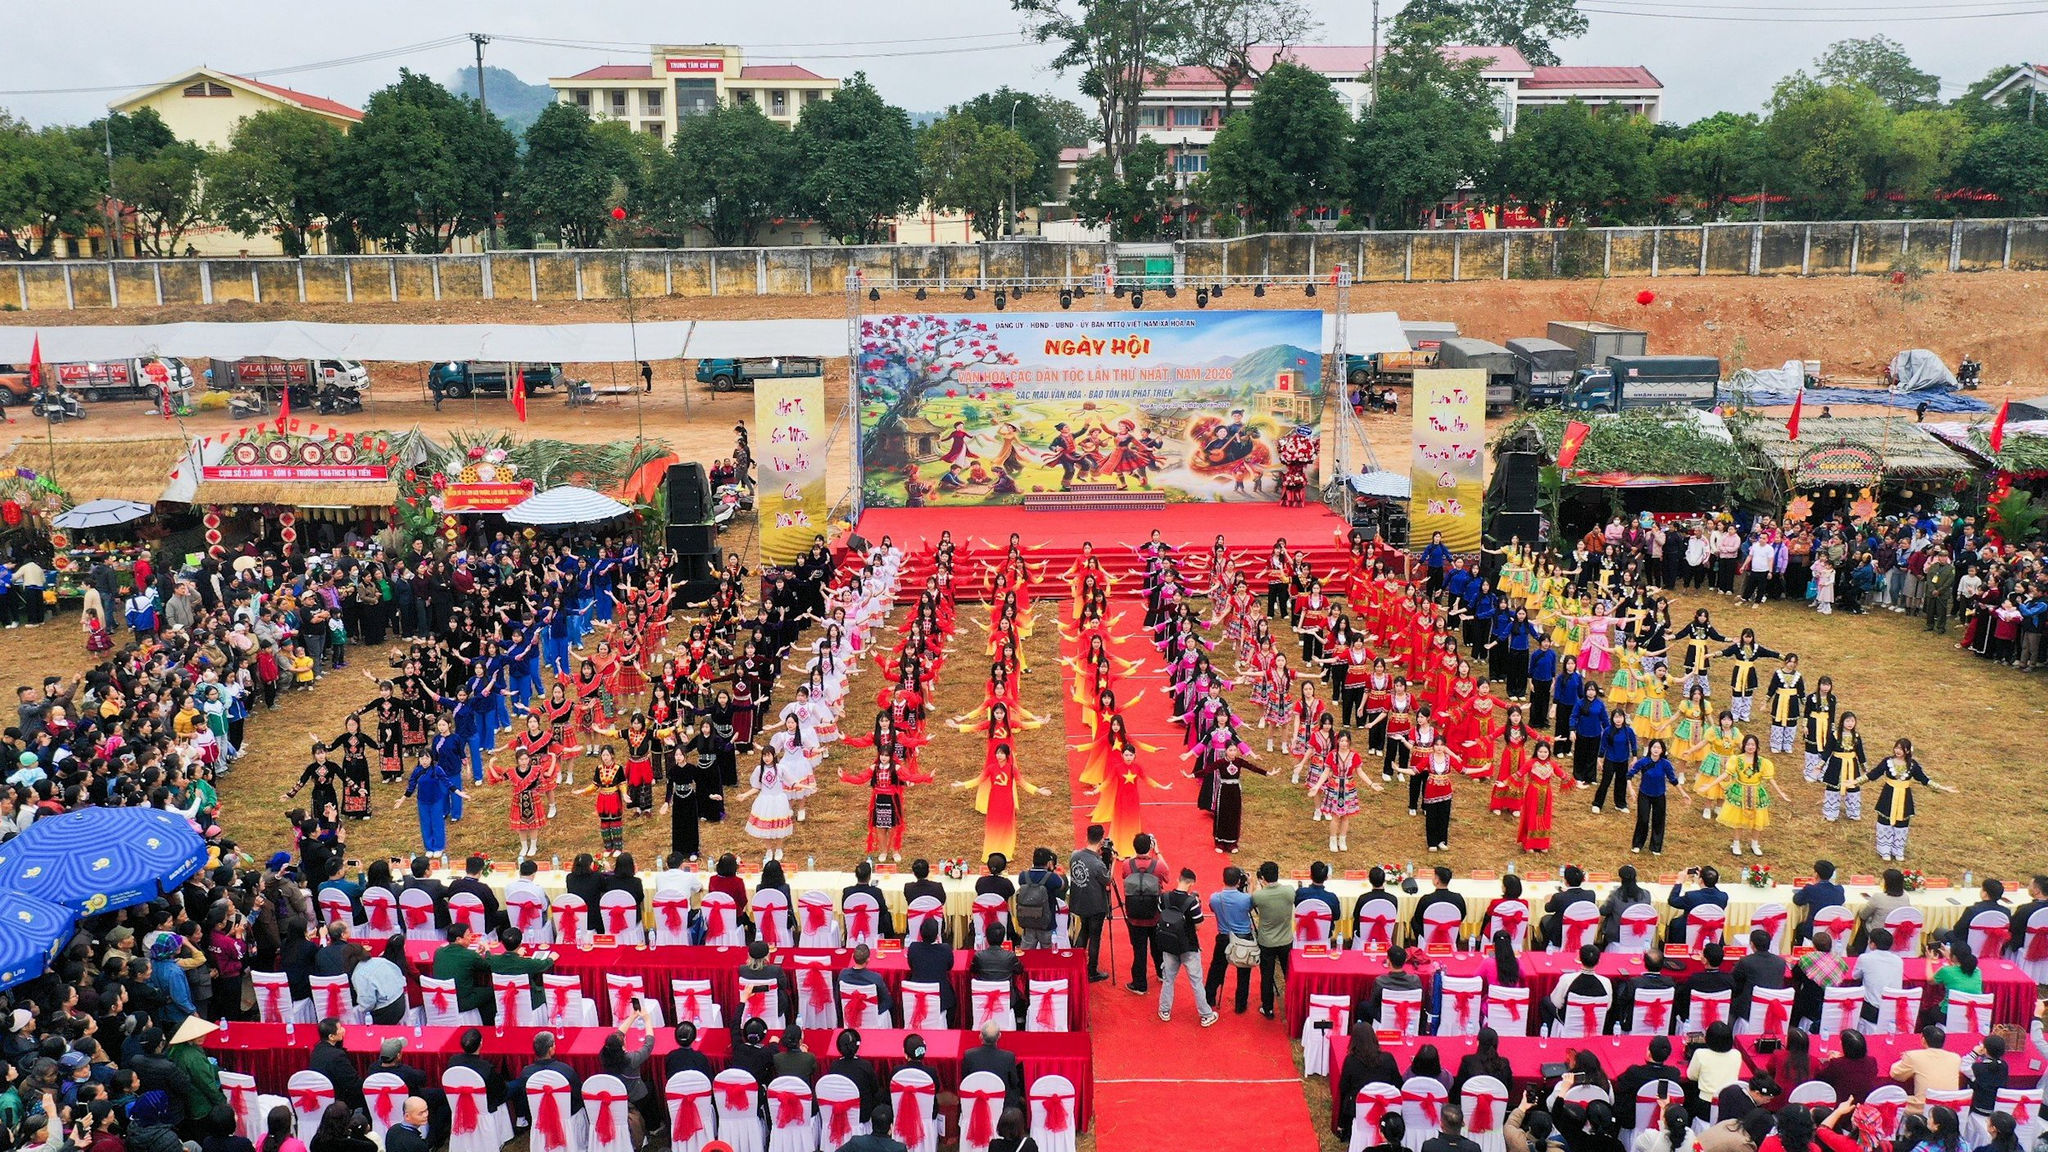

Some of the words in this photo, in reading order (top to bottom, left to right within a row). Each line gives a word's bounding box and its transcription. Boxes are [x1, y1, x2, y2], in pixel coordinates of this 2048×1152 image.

[1106, 321, 1126, 329] MTTQ
[1044, 334, 1106, 356] NGÀY
[1111, 334, 1150, 359] HỘI
[1036, 367, 1059, 382] DÂN
[1062, 365, 1084, 385] TỘC
[1088, 363, 1110, 382] LẦN
[1113, 366, 1137, 381] THỨ
[1176, 366, 1201, 381] NĂM
[1204, 367, 1233, 381] 2026
